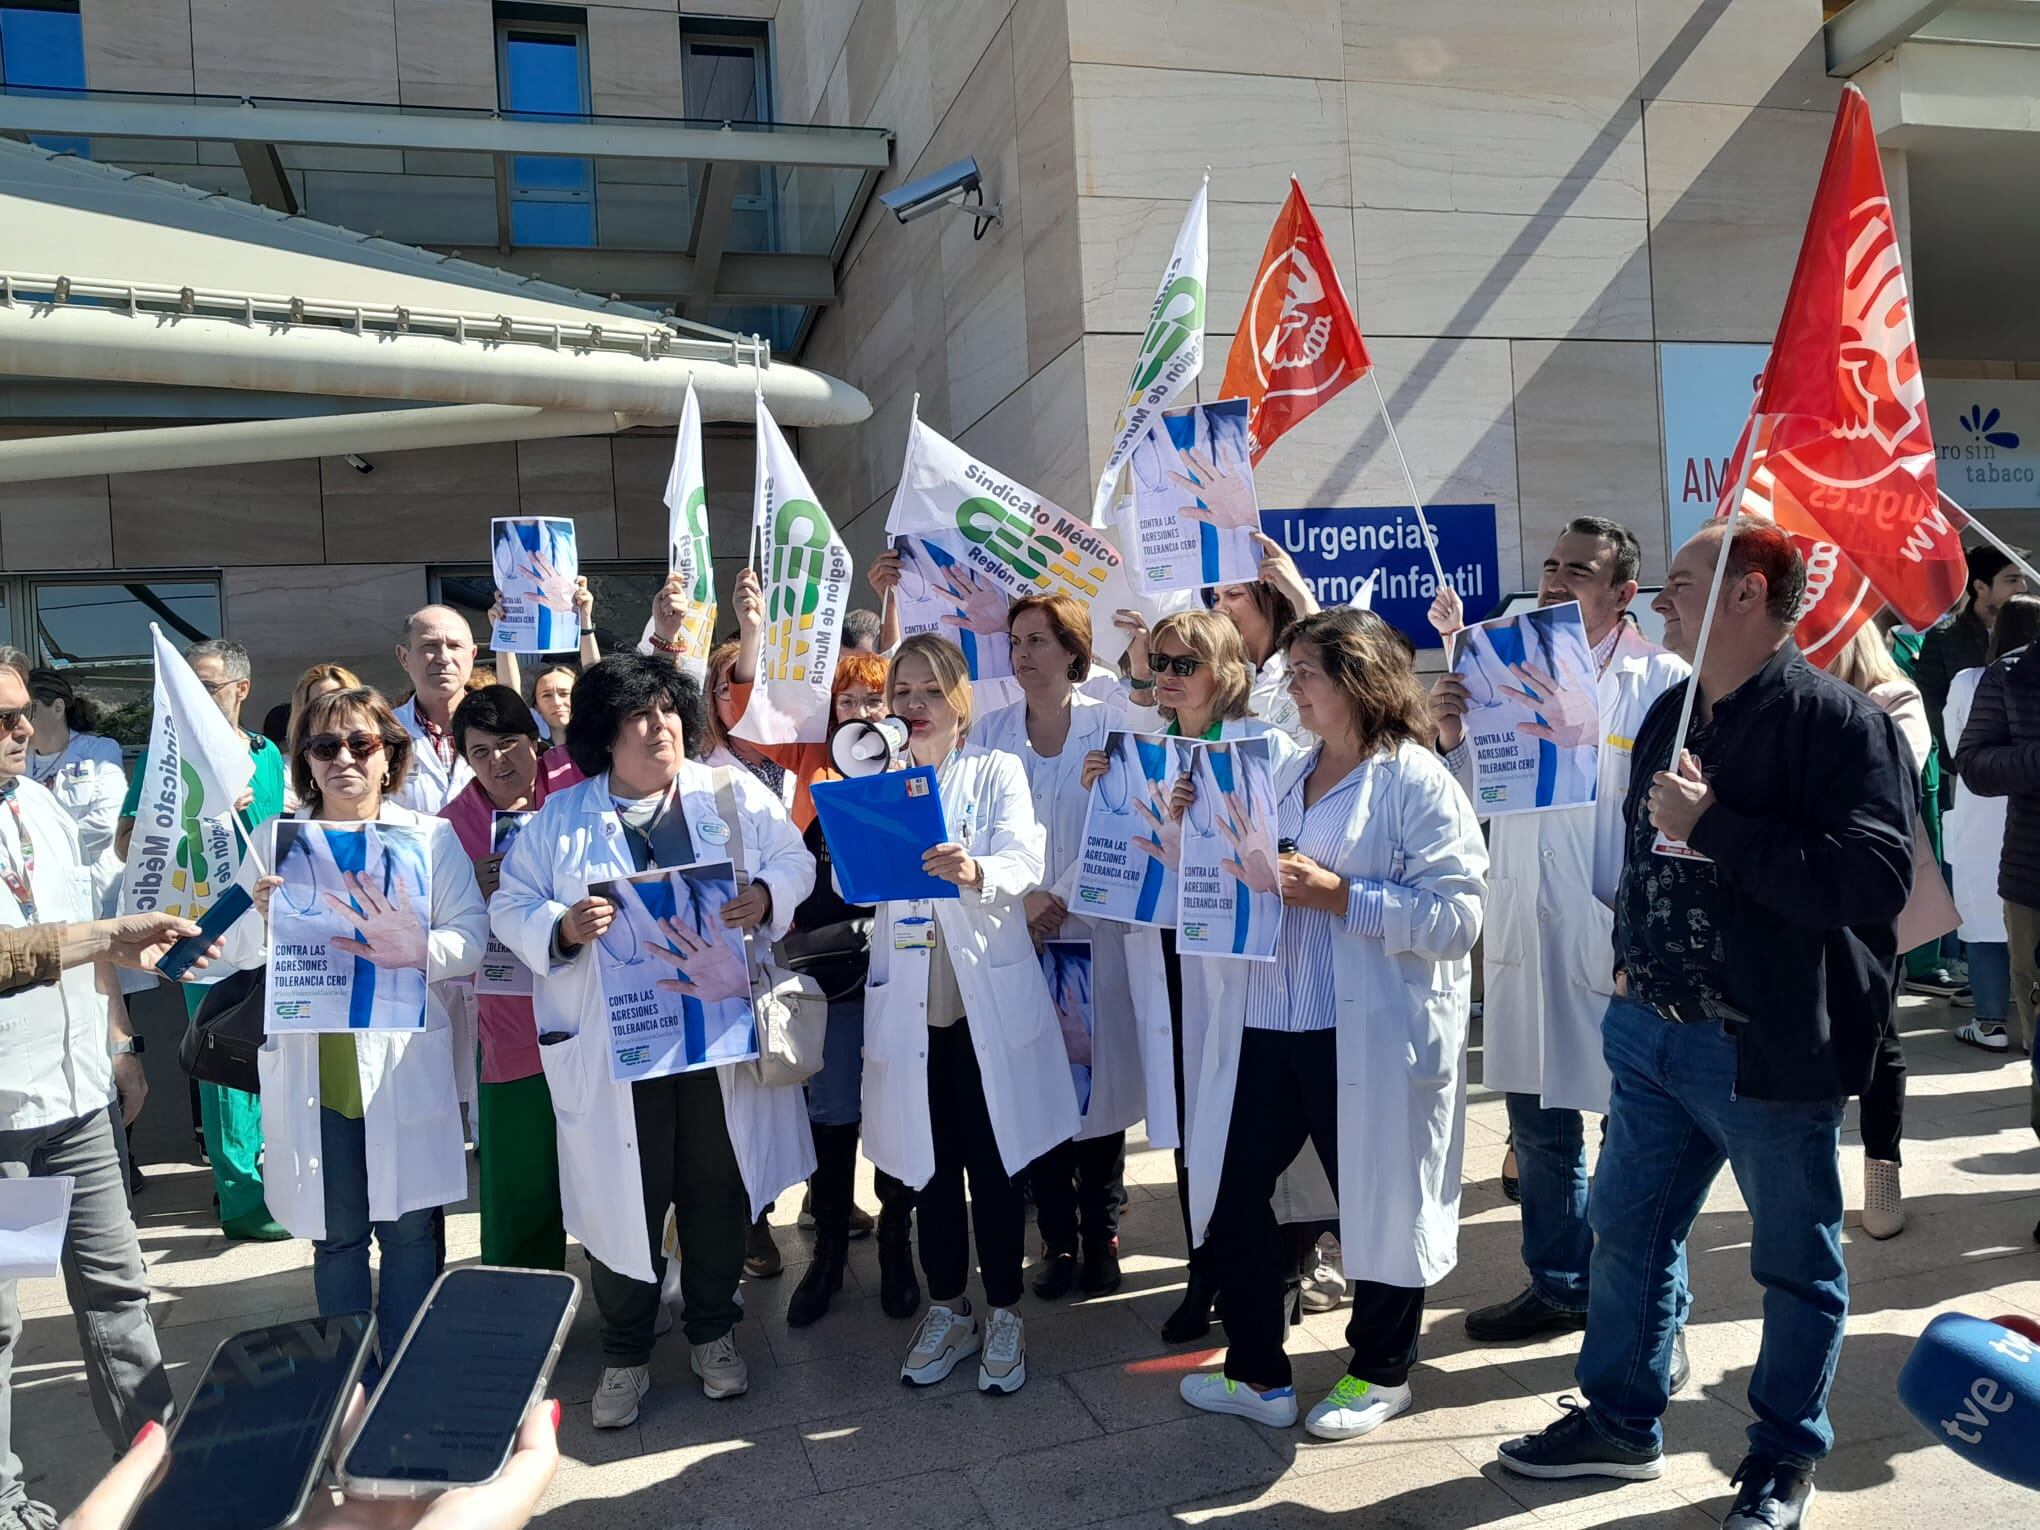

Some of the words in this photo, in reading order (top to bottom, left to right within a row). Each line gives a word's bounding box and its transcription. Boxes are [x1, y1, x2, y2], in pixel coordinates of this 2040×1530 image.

[1933, 443, 1961, 460] tro
[1964, 441, 1996, 460] sin
[1682, 457, 1731, 503] AM
[1966, 462, 2035, 482] tabaco
[964, 464, 1050, 526] Sindicato
[1052, 517, 1119, 568] Médico
[1140, 517, 1163, 530] CONTRA
[1164, 515, 1176, 526] LAS
[1141, 528, 1180, 542] AGRESIONES
[1283, 516, 1440, 560] Urgencias
[1143, 542, 1179, 556] TOLERANCIA
[1180, 539, 1197, 551] CERO
[967, 546, 1017, 587] Región
[1016, 579, 1034, 597] de
[904, 624, 928, 634] CONTRA
[928, 622, 939, 632] LAS
[1474, 732, 1501, 746] CONTRA
[1502, 731, 1515, 743] LAS
[1477, 745, 1519, 760] AGRESIONES
[1479, 759, 1517, 775] TOLERANCIA
[1518, 758, 1535, 770] CERO
[1087, 836, 1113, 849] CONTRA
[1114, 840, 1128, 851] LAS
[1084, 849, 1127, 866] AGRESIONES
[1082, 862, 1122, 878] TOLERANCIA
[1122, 870, 1140, 882] CERO
[1184, 866, 1207, 878] CONTRA
[1208, 866, 1219, 878] LAS
[1183, 881, 1220, 894] AGRESIONES
[1183, 897, 1218, 909] TOLERANCIA
[1218, 898, 1233, 910] CERO
[275, 944, 309, 956] CONTRA
[310, 944, 326, 956] LAS
[274, 959, 328, 972] AGRESIONES
[274, 975, 325, 987] TOLERANCIA
[326, 975, 347, 986] CERO
[608, 992, 639, 1008] CONTRA
[640, 989, 655, 1002] LAS
[611, 1003, 659, 1022] AGRESIONES
[613, 1019, 658, 1037] TOLERANCIA
[659, 1015, 679, 1028] CERO
[1940, 1377, 2015, 1445] tve
